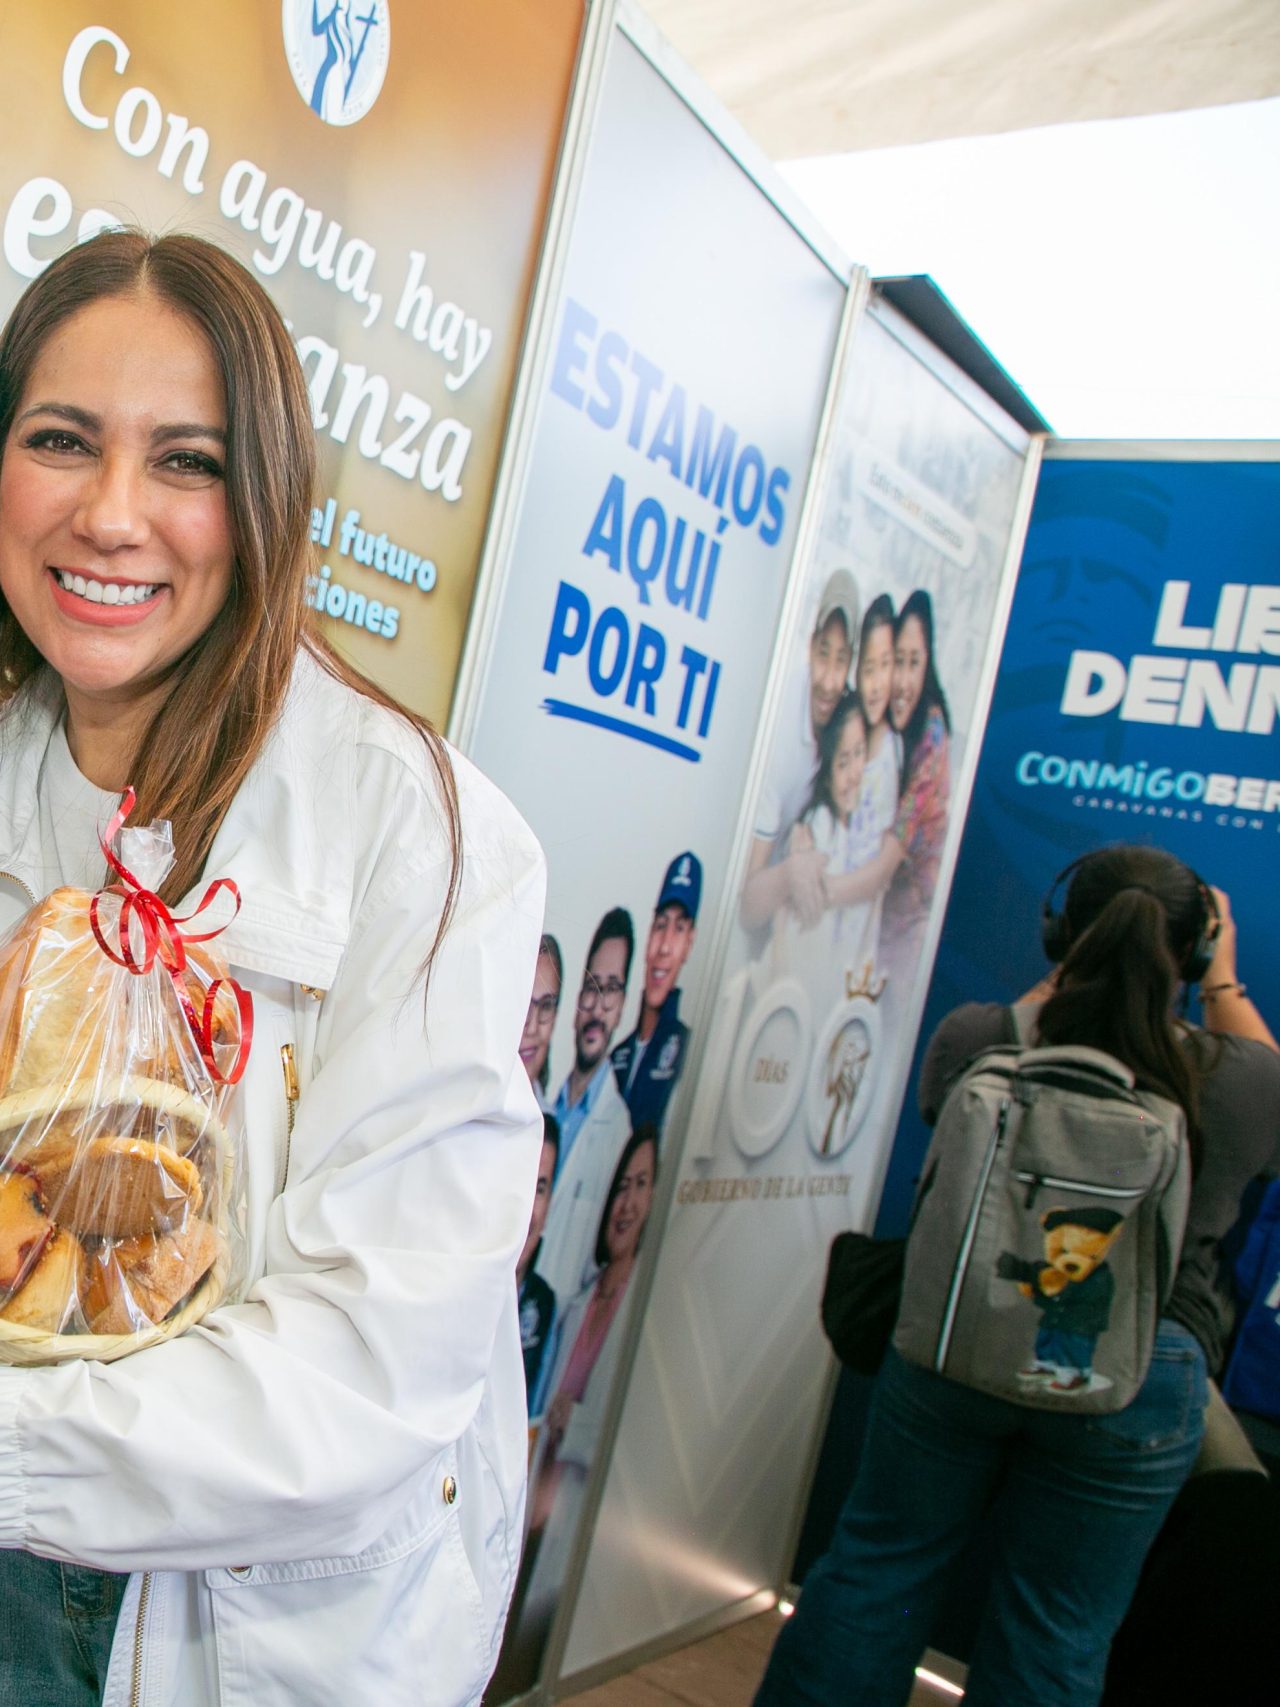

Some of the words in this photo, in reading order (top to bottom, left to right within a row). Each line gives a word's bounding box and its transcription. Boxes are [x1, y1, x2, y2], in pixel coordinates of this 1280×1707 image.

[62, 25, 209, 194] Con
[220, 159, 383, 328] agua,
[394, 250, 492, 391] hay
[549, 296, 791, 547] ESTAMOS
[339, 508, 438, 593] futuro
[581, 473, 731, 622] AQUÍ
[543, 580, 667, 717] POR
[675, 643, 723, 739] TI
[1072, 795, 1204, 823] CARAVANAS
[1214, 813, 1264, 831] CON
